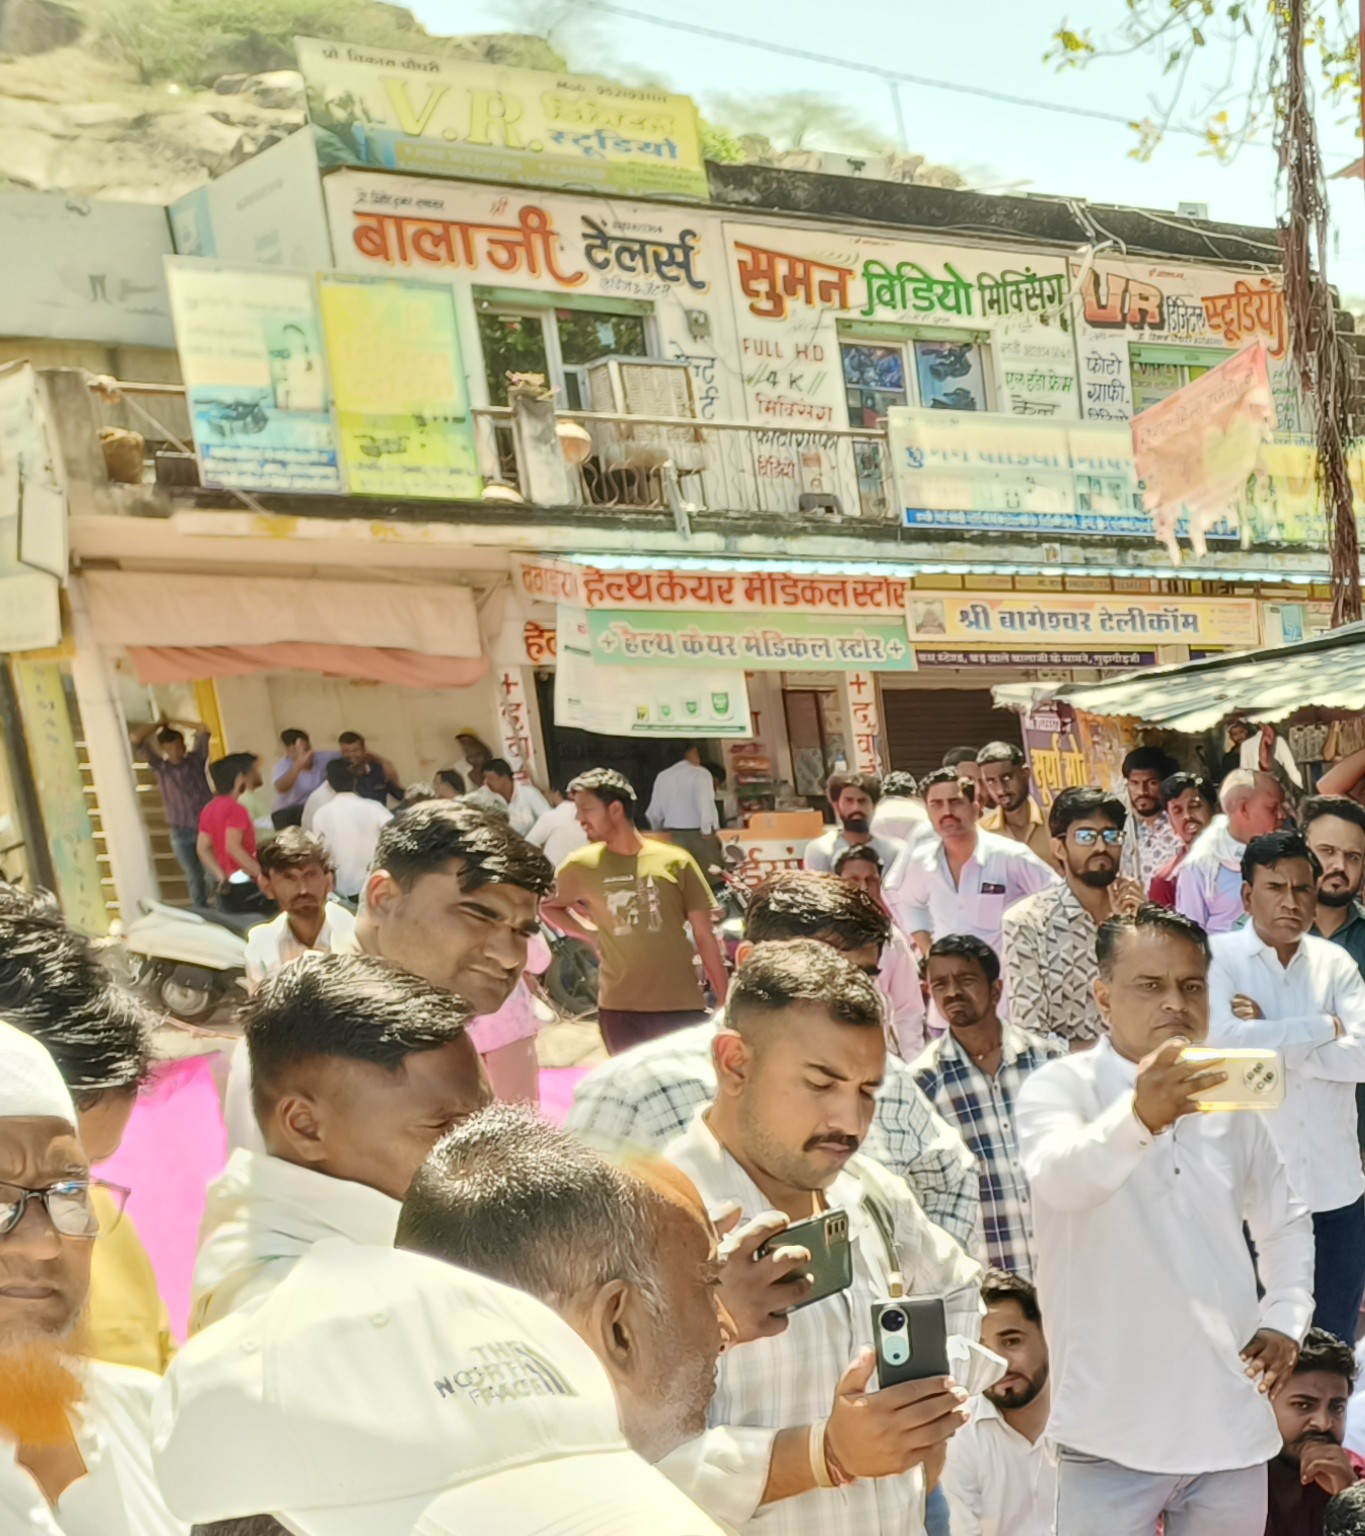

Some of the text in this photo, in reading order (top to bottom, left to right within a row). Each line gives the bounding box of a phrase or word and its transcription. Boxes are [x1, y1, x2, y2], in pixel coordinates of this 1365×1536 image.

[353, 205, 706, 290] बालाजी टेलर्स
[734, 241, 854, 318] सुमन
[861, 259, 973, 316] विडियो
[743, 337, 784, 359] FULL
[1085, 350, 1124, 375] फोटो
[959, 603, 991, 632] श्री
[998, 605, 1090, 633] बागेश्वर
[1099, 606, 1199, 634] टेलीकॉम
[469, 1340, 522, 1363] THE
